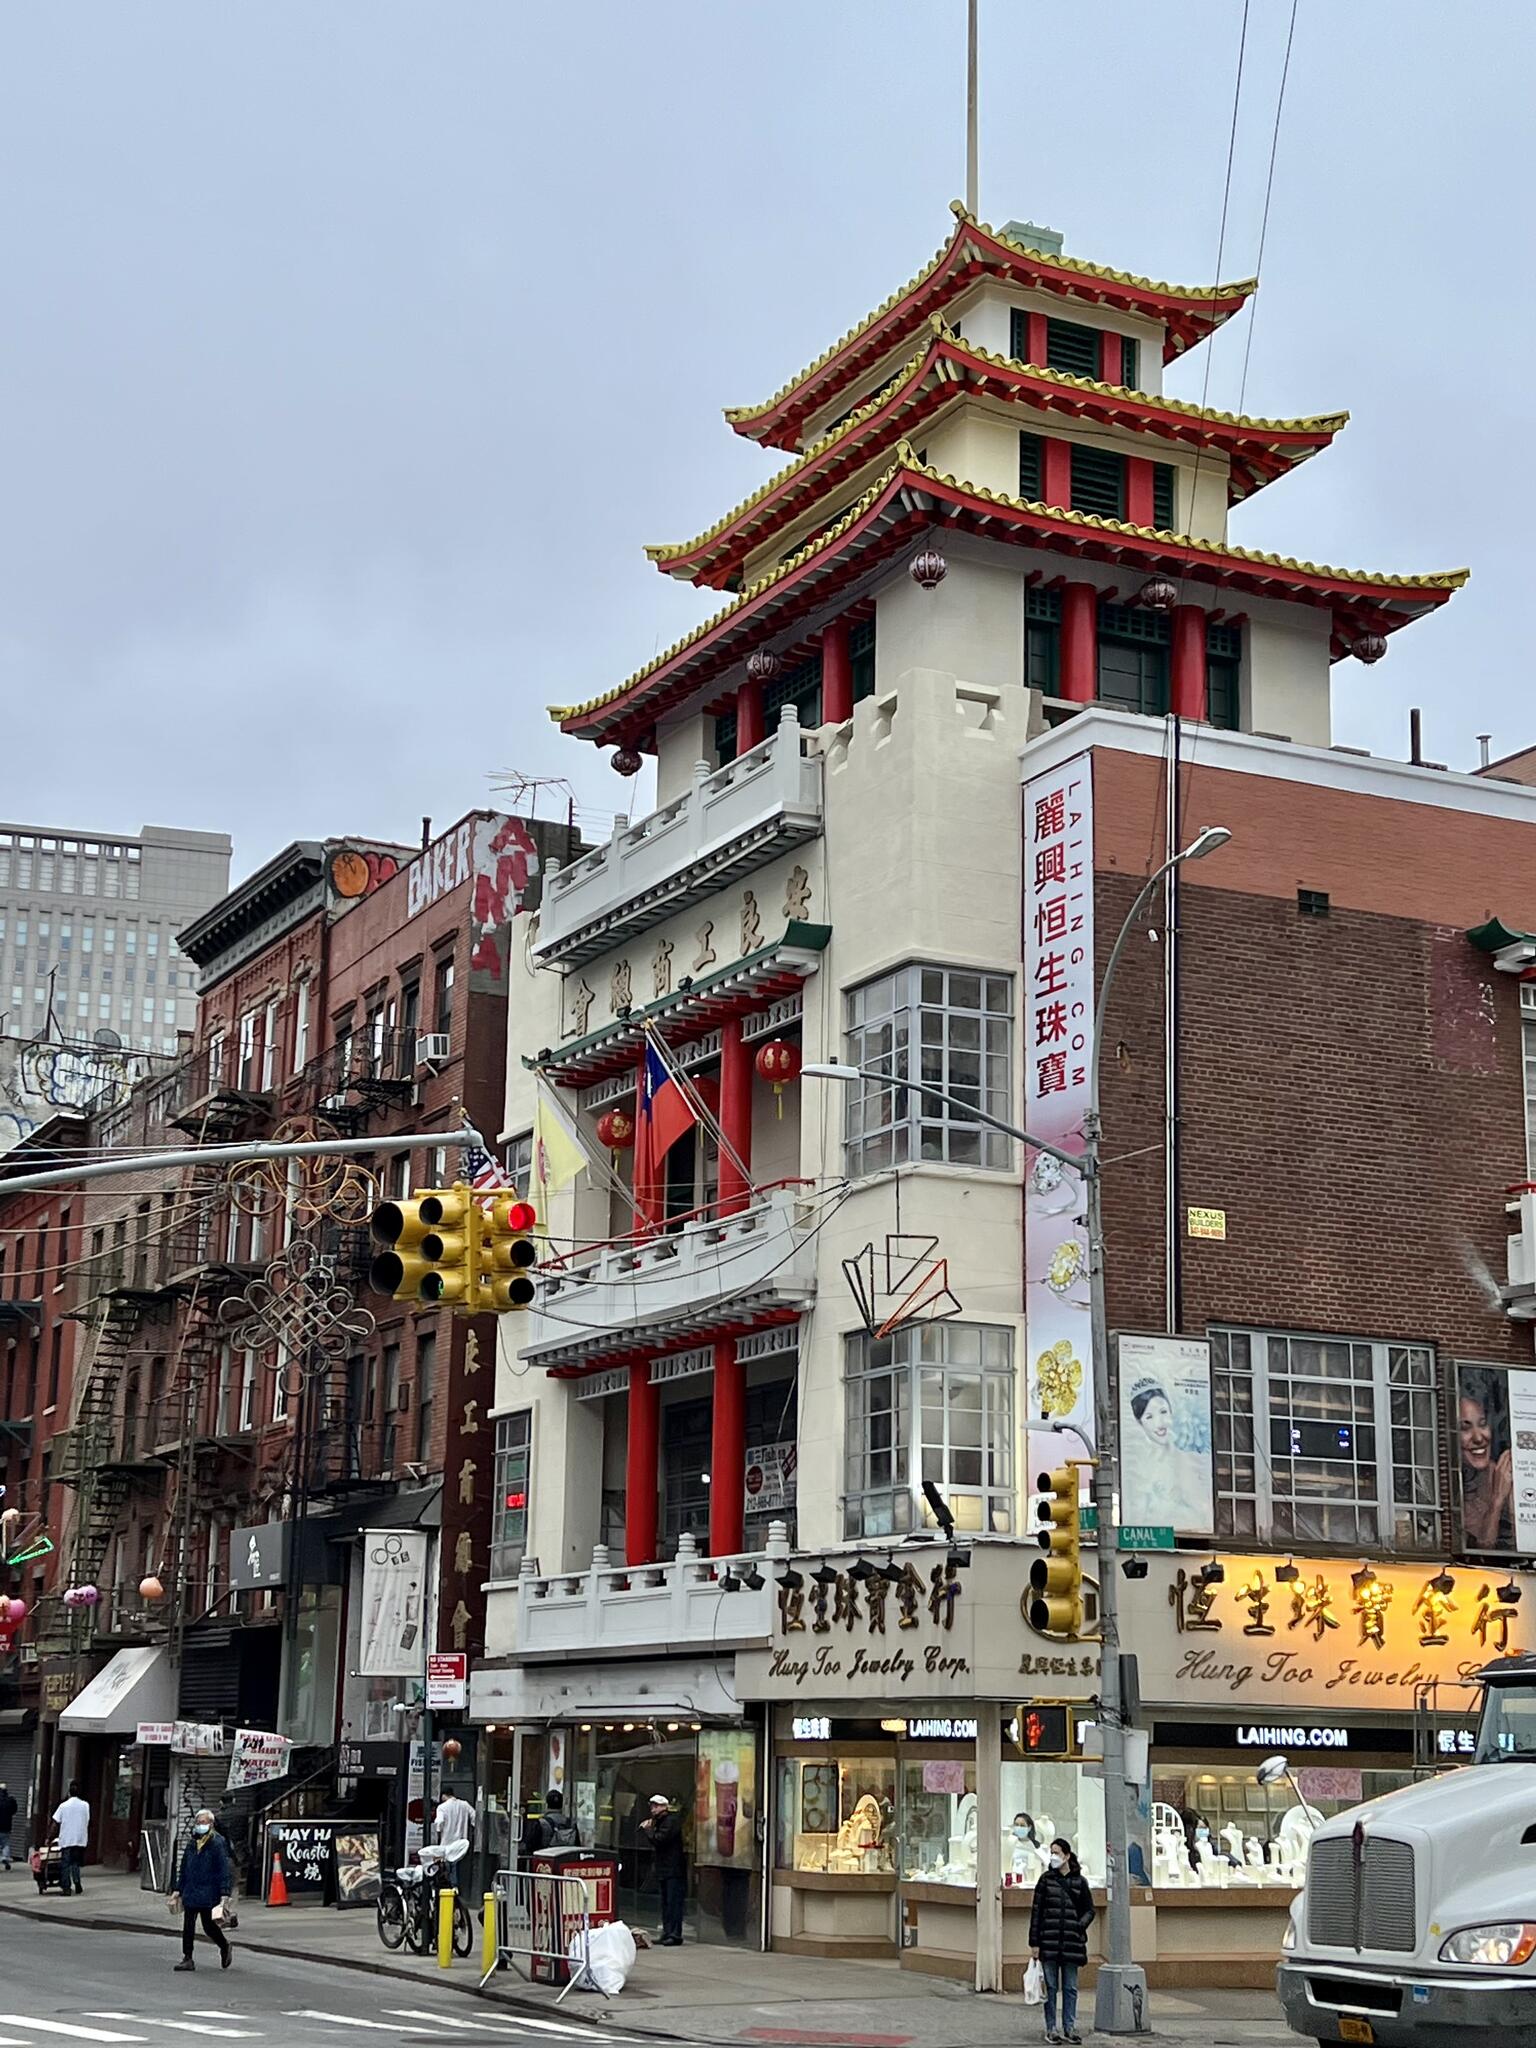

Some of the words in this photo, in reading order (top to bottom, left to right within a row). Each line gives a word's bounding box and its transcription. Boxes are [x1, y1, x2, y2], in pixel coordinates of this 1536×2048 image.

[407, 823, 471, 918] BAKER
[1033, 787, 1068, 1099] 麗興恒生珠寶
[1069, 780, 1085, 1087] LAIHING.COM
[1190, 1210, 1224, 1221] NEXUS
[1123, 1528, 1157, 1541] CANAL
[768, 1649, 808, 1685] Hung
[812, 1645, 841, 1675] Too
[847, 1649, 914, 1681] Jewelry
[924, 1646, 970, 1679] Corp.
[1176, 1650, 1253, 1690] Hung
[1261, 1652, 1313, 1682] Too
[1325, 1660, 1440, 1695] Jewelry
[909, 1719, 978, 1738] LAIHING.COM
[1237, 1727, 1348, 1747] LAIHING.COM
[279, 1829, 310, 1840] HAY
